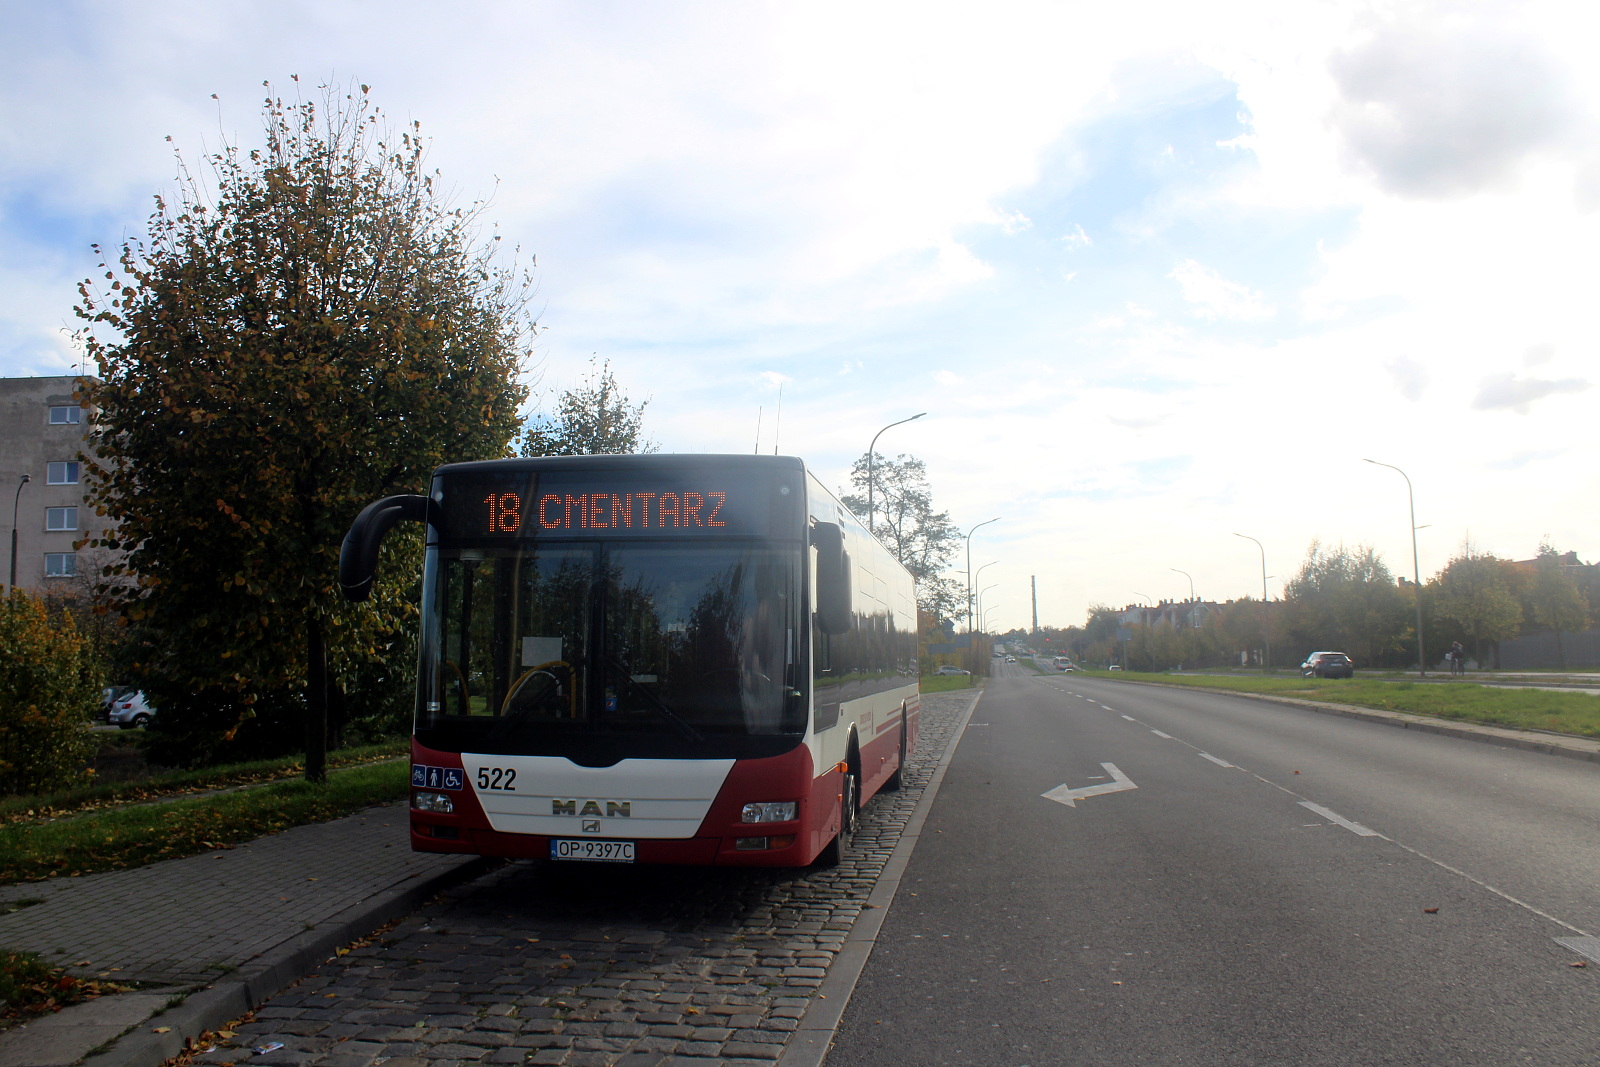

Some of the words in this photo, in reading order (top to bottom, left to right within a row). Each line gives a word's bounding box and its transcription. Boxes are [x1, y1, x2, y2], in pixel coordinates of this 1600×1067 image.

[484, 493, 520, 532] 18
[539, 492, 725, 529] CMENTARZ
[477, 767, 517, 791] 522
[552, 799, 631, 817] MAN
[559, 841, 580, 856] OP
[586, 842, 632, 858] 9397C
